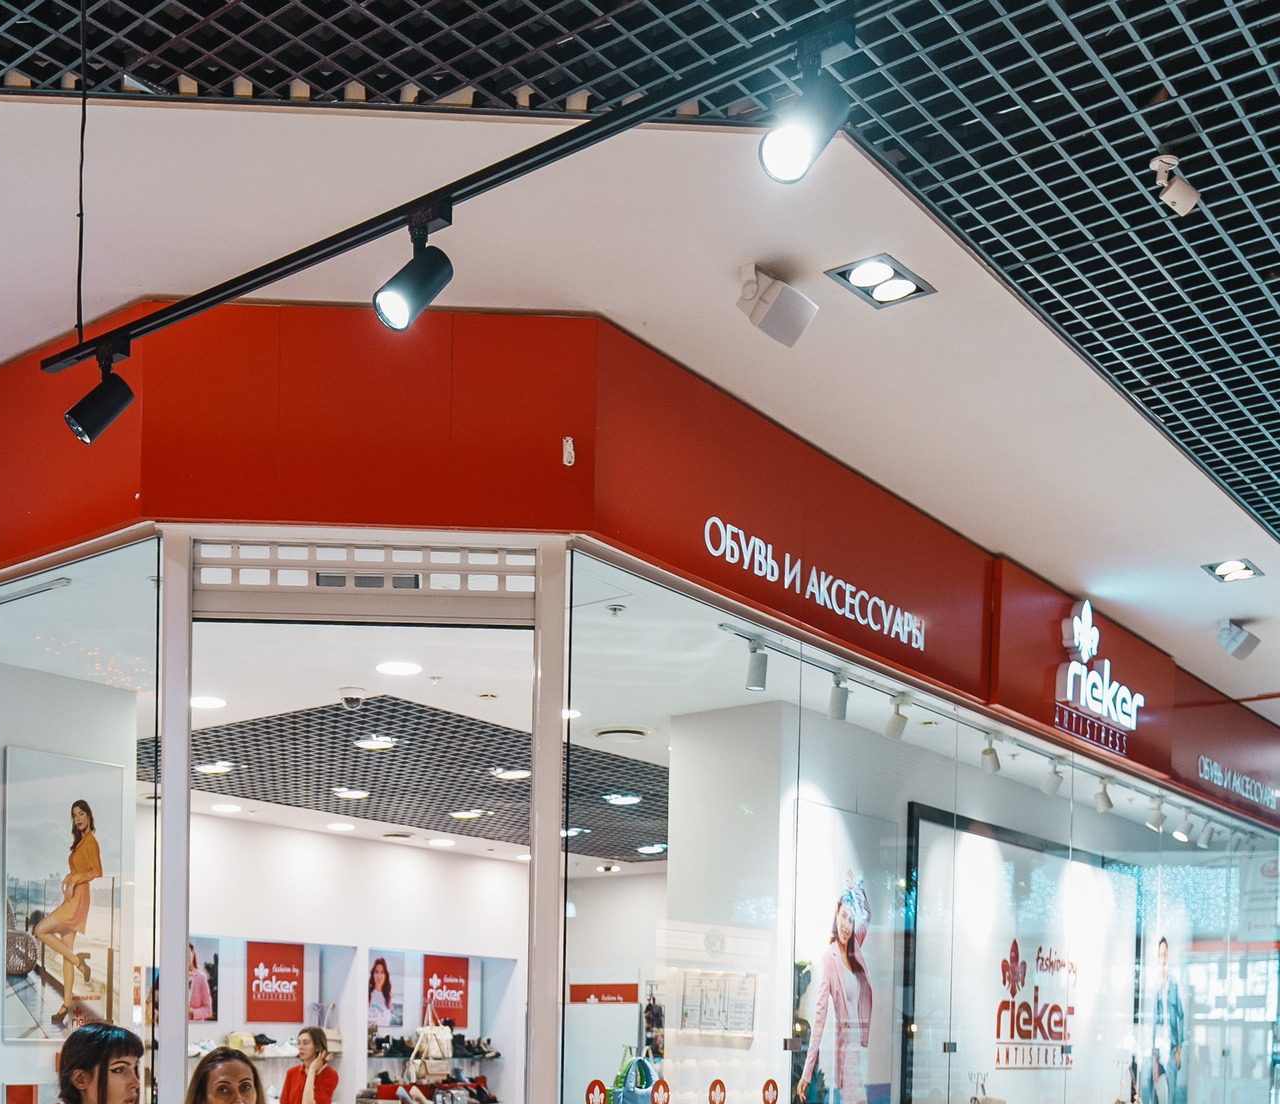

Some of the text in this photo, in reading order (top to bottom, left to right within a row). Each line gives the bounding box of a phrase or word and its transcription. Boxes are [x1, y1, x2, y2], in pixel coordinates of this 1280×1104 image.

[704, 516, 925, 652] ОБУВЬ И АКСЕССУАРЫ
[1066, 658, 1145, 731] rieker
[1055, 704, 1128, 754] ANTISTRESS
[251, 975, 298, 993] rieker
[427, 984, 464, 1001] rieker
[995, 985, 1075, 1041] rieker
